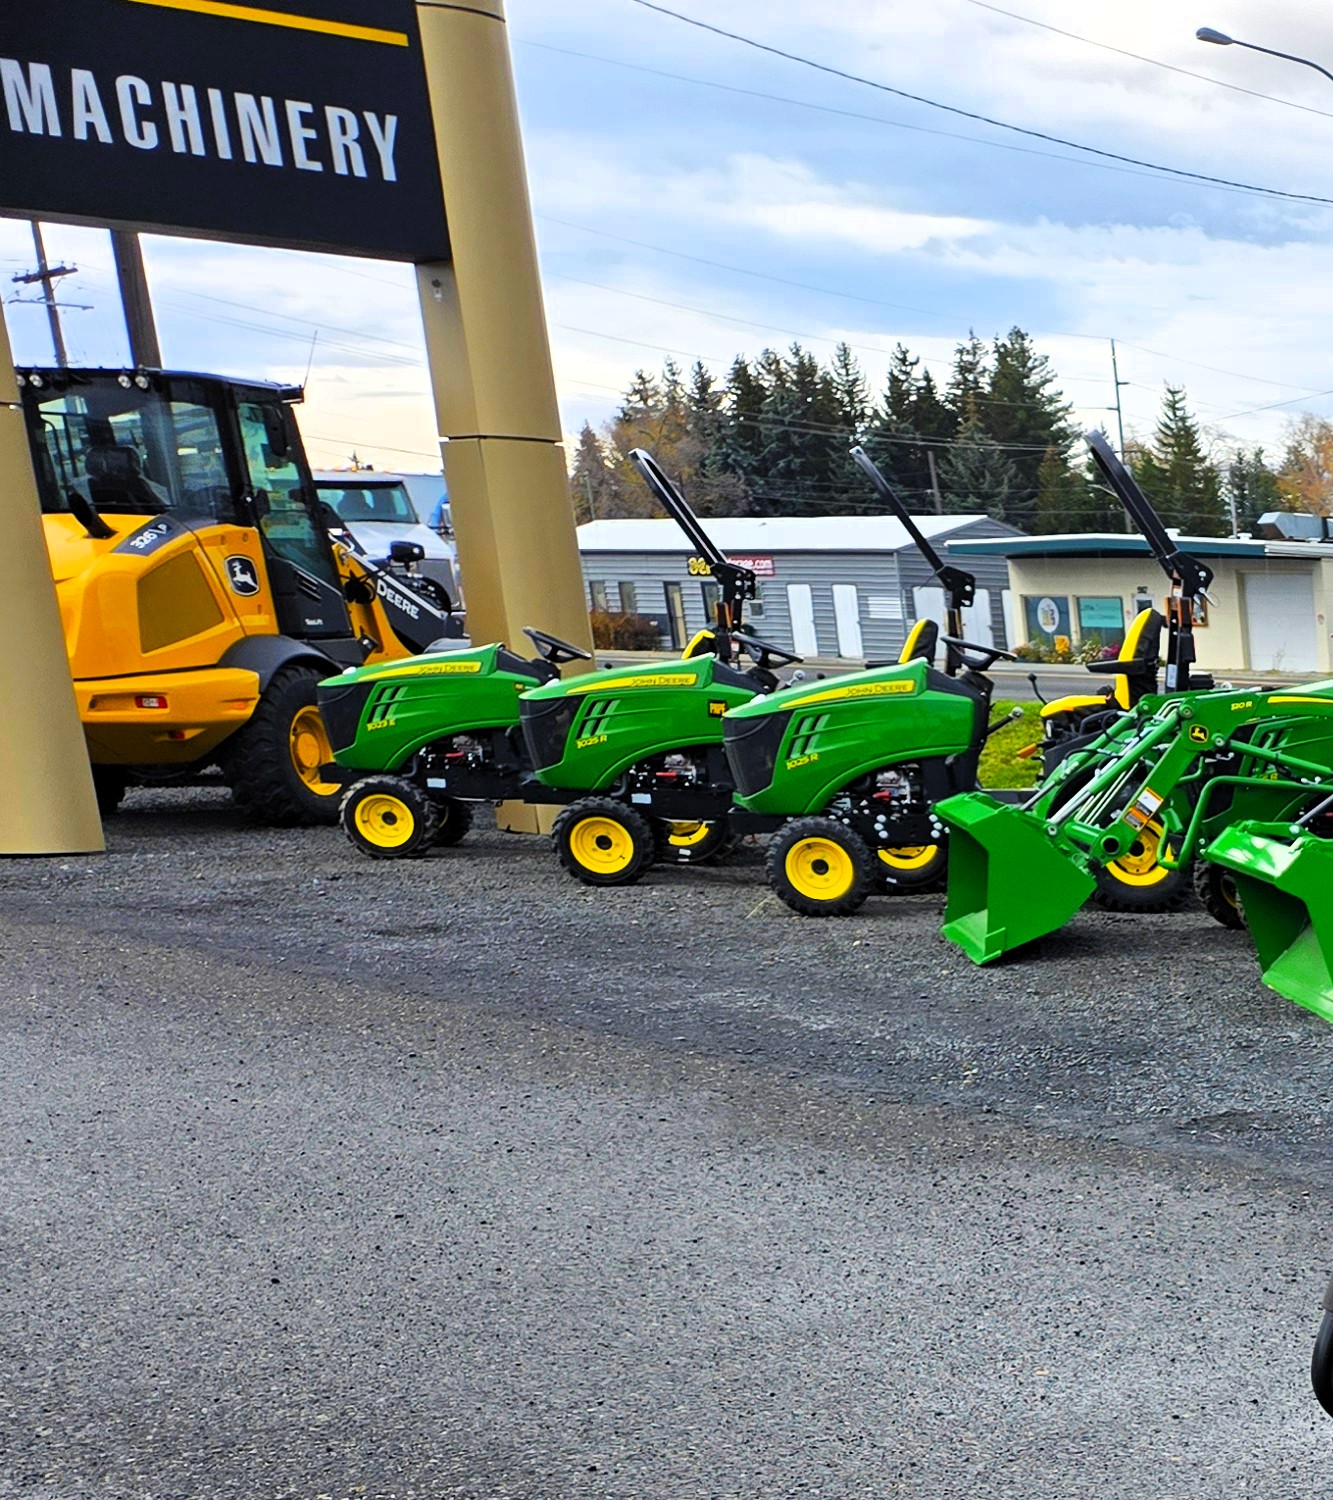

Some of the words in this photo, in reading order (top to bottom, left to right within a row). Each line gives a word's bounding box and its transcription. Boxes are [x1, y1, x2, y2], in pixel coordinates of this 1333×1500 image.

[0, 58, 397, 181] MACHINERY
[376, 578, 419, 620] DEERE
[417, 666, 443, 675] JOHN
[444, 664, 476, 672] DEERE
[631, 678, 657, 687] JOHN
[658, 676, 691, 685] DEERE
[846, 687, 873, 696] JOHN
[874, 684, 908, 692] DEERE
